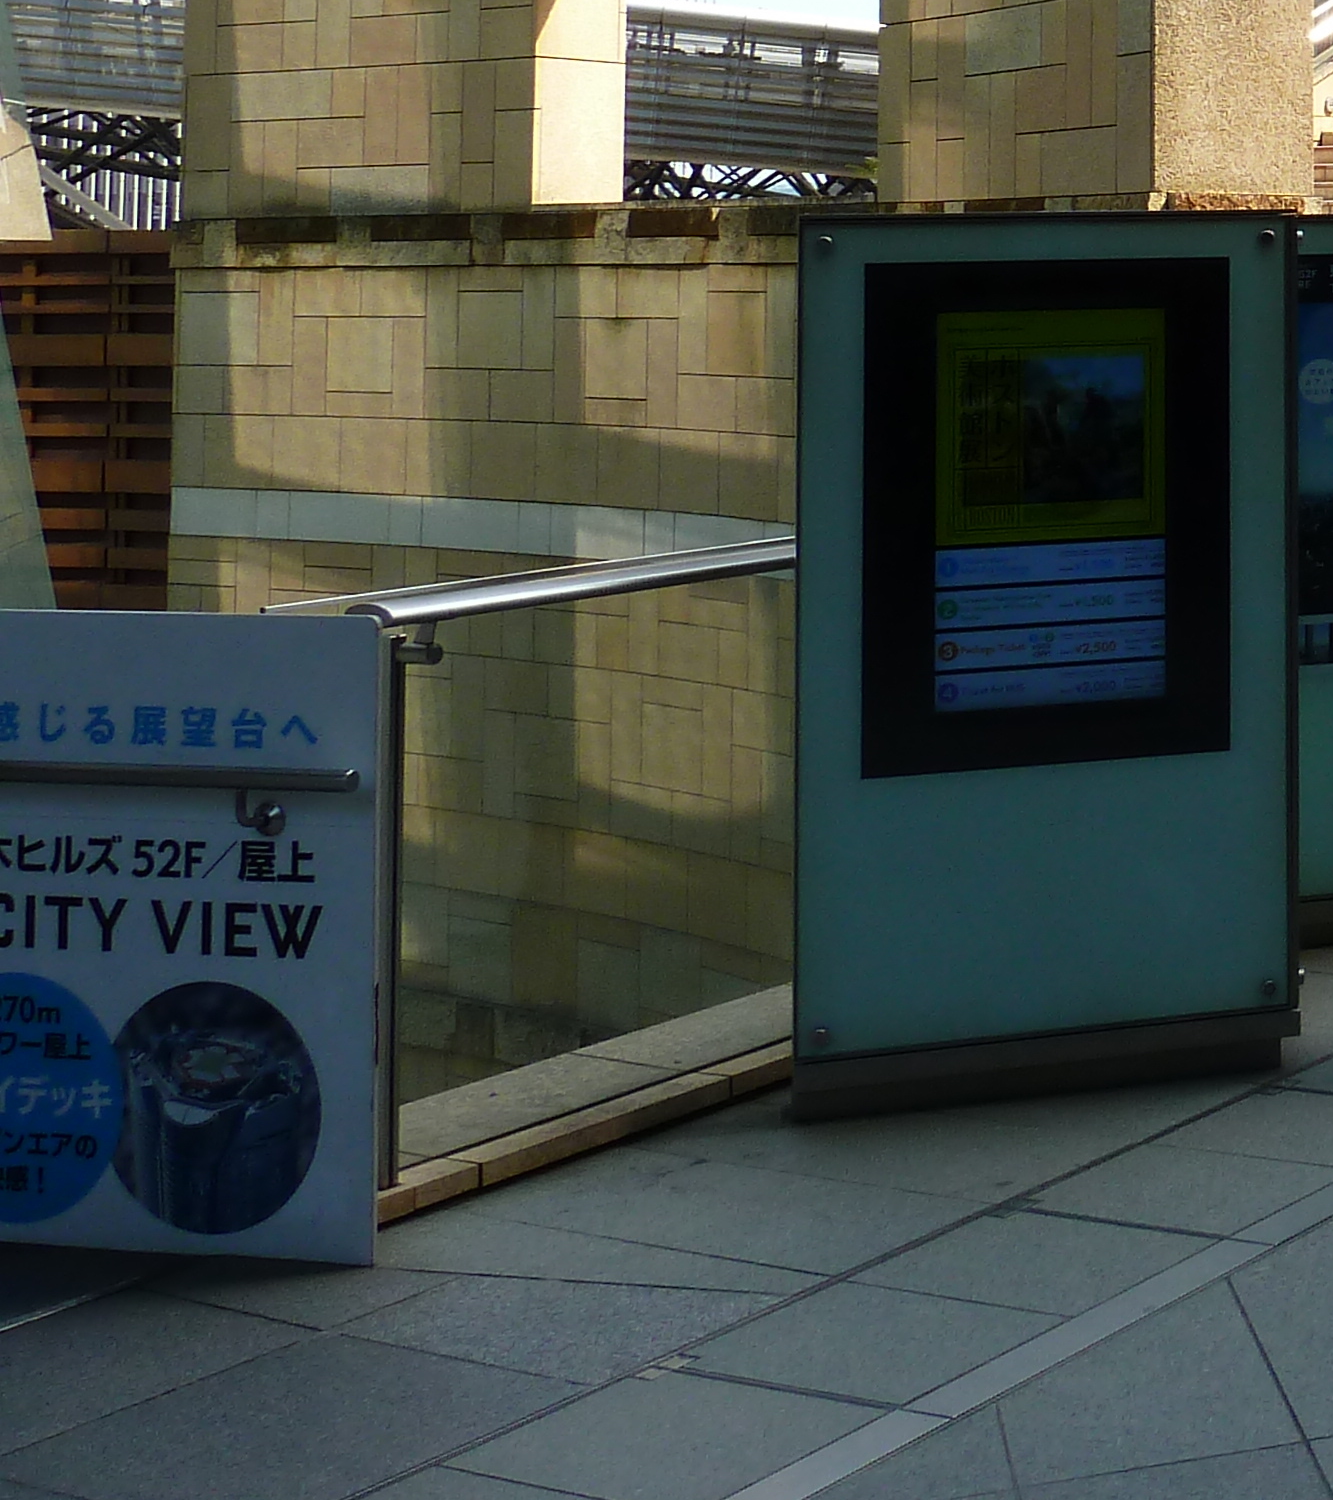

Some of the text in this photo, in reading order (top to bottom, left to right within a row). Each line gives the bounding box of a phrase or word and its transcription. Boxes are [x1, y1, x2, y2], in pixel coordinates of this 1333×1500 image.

[151, 899, 323, 960] VIEW
[0, 995, 61, 1024] 70m
[0, 1132, 98, 1160] ンエアの
